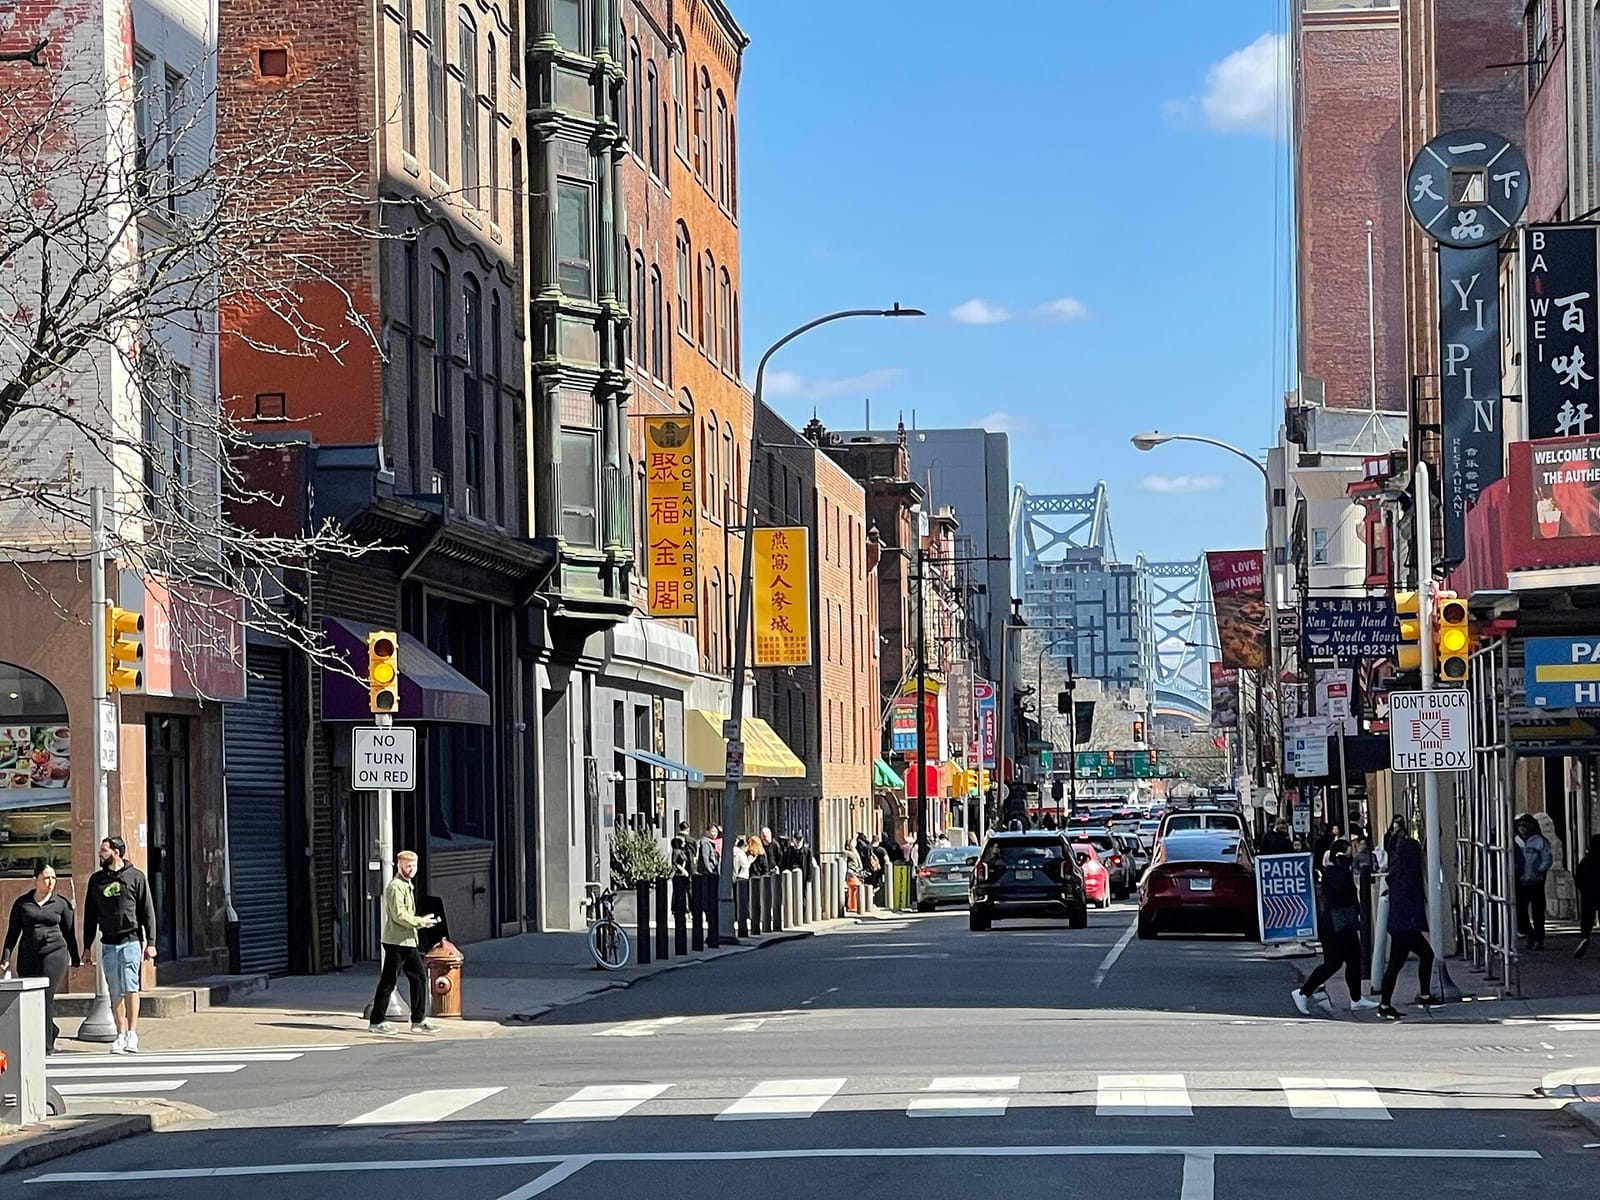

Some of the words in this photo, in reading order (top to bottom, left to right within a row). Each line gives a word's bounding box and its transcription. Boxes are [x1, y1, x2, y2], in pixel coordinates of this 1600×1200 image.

[1450, 272, 1485, 331] YI
[1551, 291, 1595, 436] 百味軒
[1445, 343, 1495, 433] PIN
[1535, 447, 1588, 465] WELCOME
[1453, 438, 1463, 518] RESTAURANT
[1543, 471, 1563, 485] THE
[681, 454, 693, 520] OCEAN
[650, 451, 680, 610] 聚福金閣
[682, 526, 695, 604] HARBOR
[1306, 616, 1326, 628] Nan
[1331, 615, 1355, 628] Zhou
[1361, 615, 1387, 628] Hand
[1332, 630, 1366, 643] Noodle
[1311, 644, 1333, 656] Tel:
[1337, 644, 1396, 656] 215-923-1
[1429, 694, 1465, 708] BLOCK
[373, 735, 395, 747] NO
[985, 710, 994, 756] PARKING
[364, 752, 404, 764] TURN
[1398, 752, 1427, 768] THE
[1434, 751, 1467, 767] BOX
[359, 770, 378, 782] ON
[383, 770, 408, 782] RED
[1261, 861, 1306, 878] PARK
[1262, 878, 1307, 895] HERE
